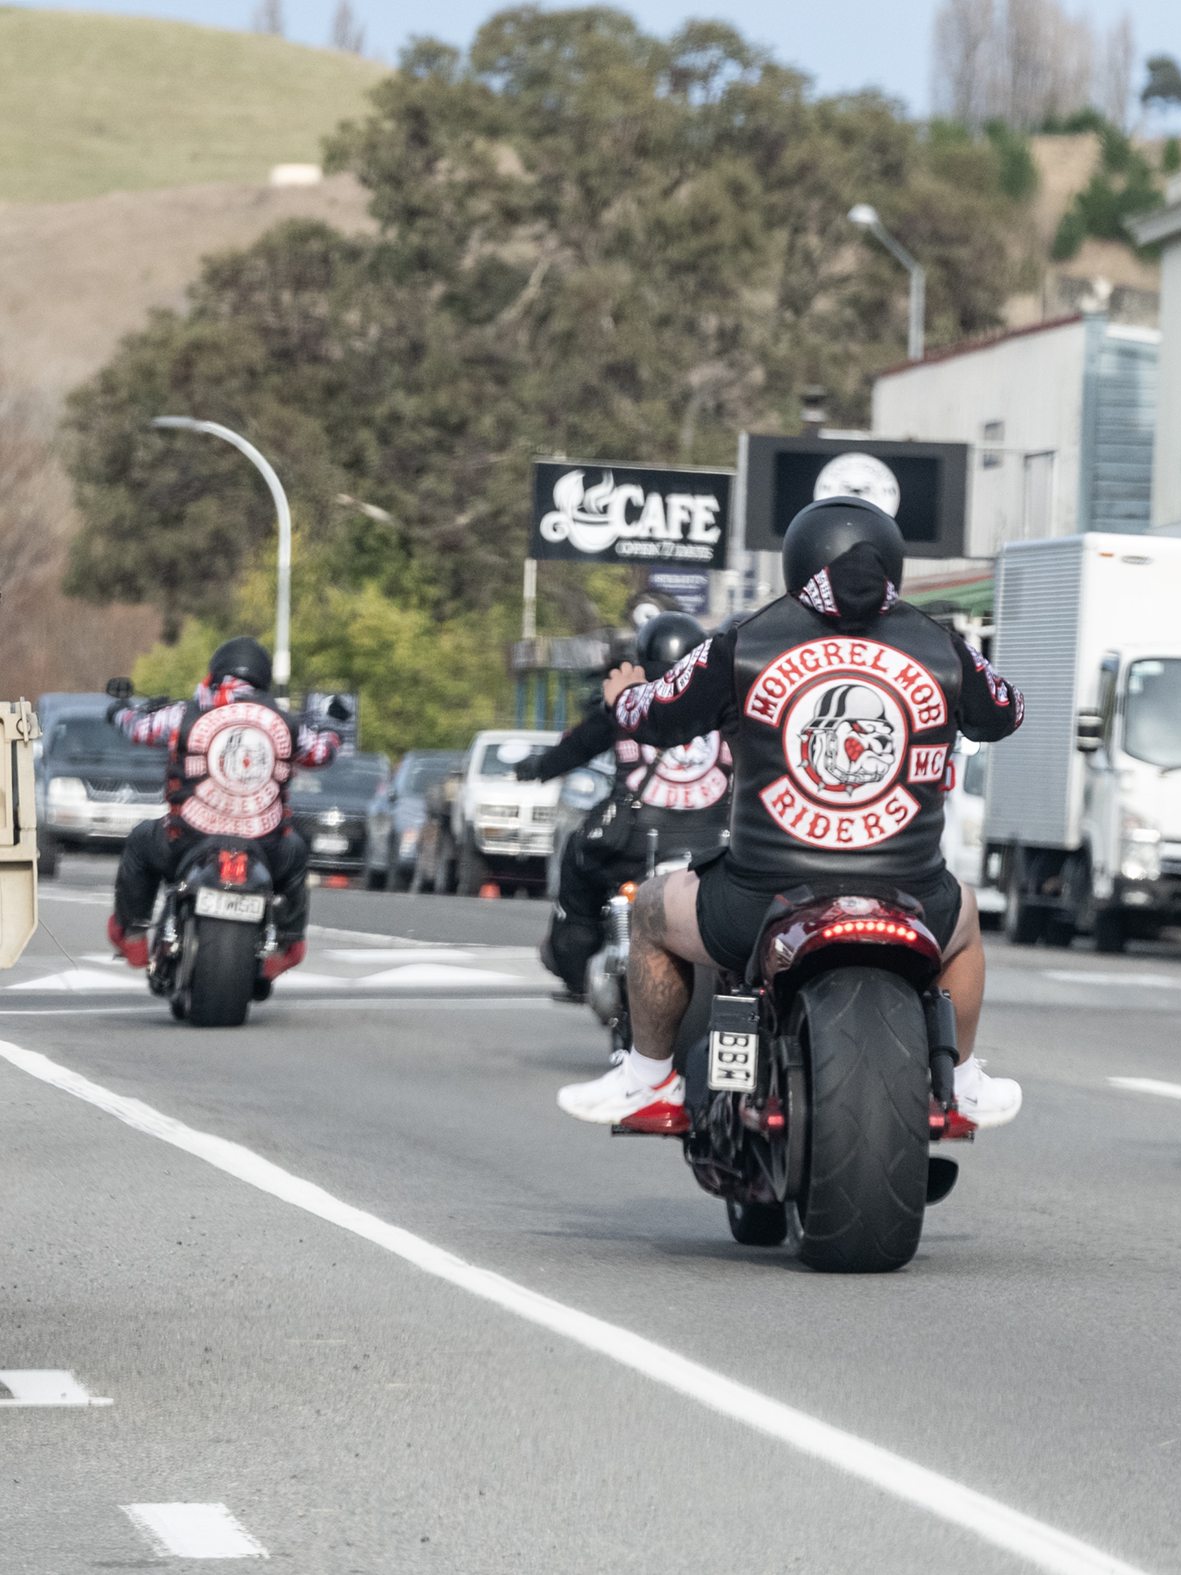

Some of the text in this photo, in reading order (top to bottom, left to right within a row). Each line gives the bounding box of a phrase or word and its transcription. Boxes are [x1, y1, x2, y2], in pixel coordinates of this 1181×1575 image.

[607, 483, 721, 544] CAFE
[751, 642, 889, 720] MONGREL
[893, 663, 941, 724] MOB
[914, 752, 943, 776] MC
[771, 788, 908, 843] RIDERS
